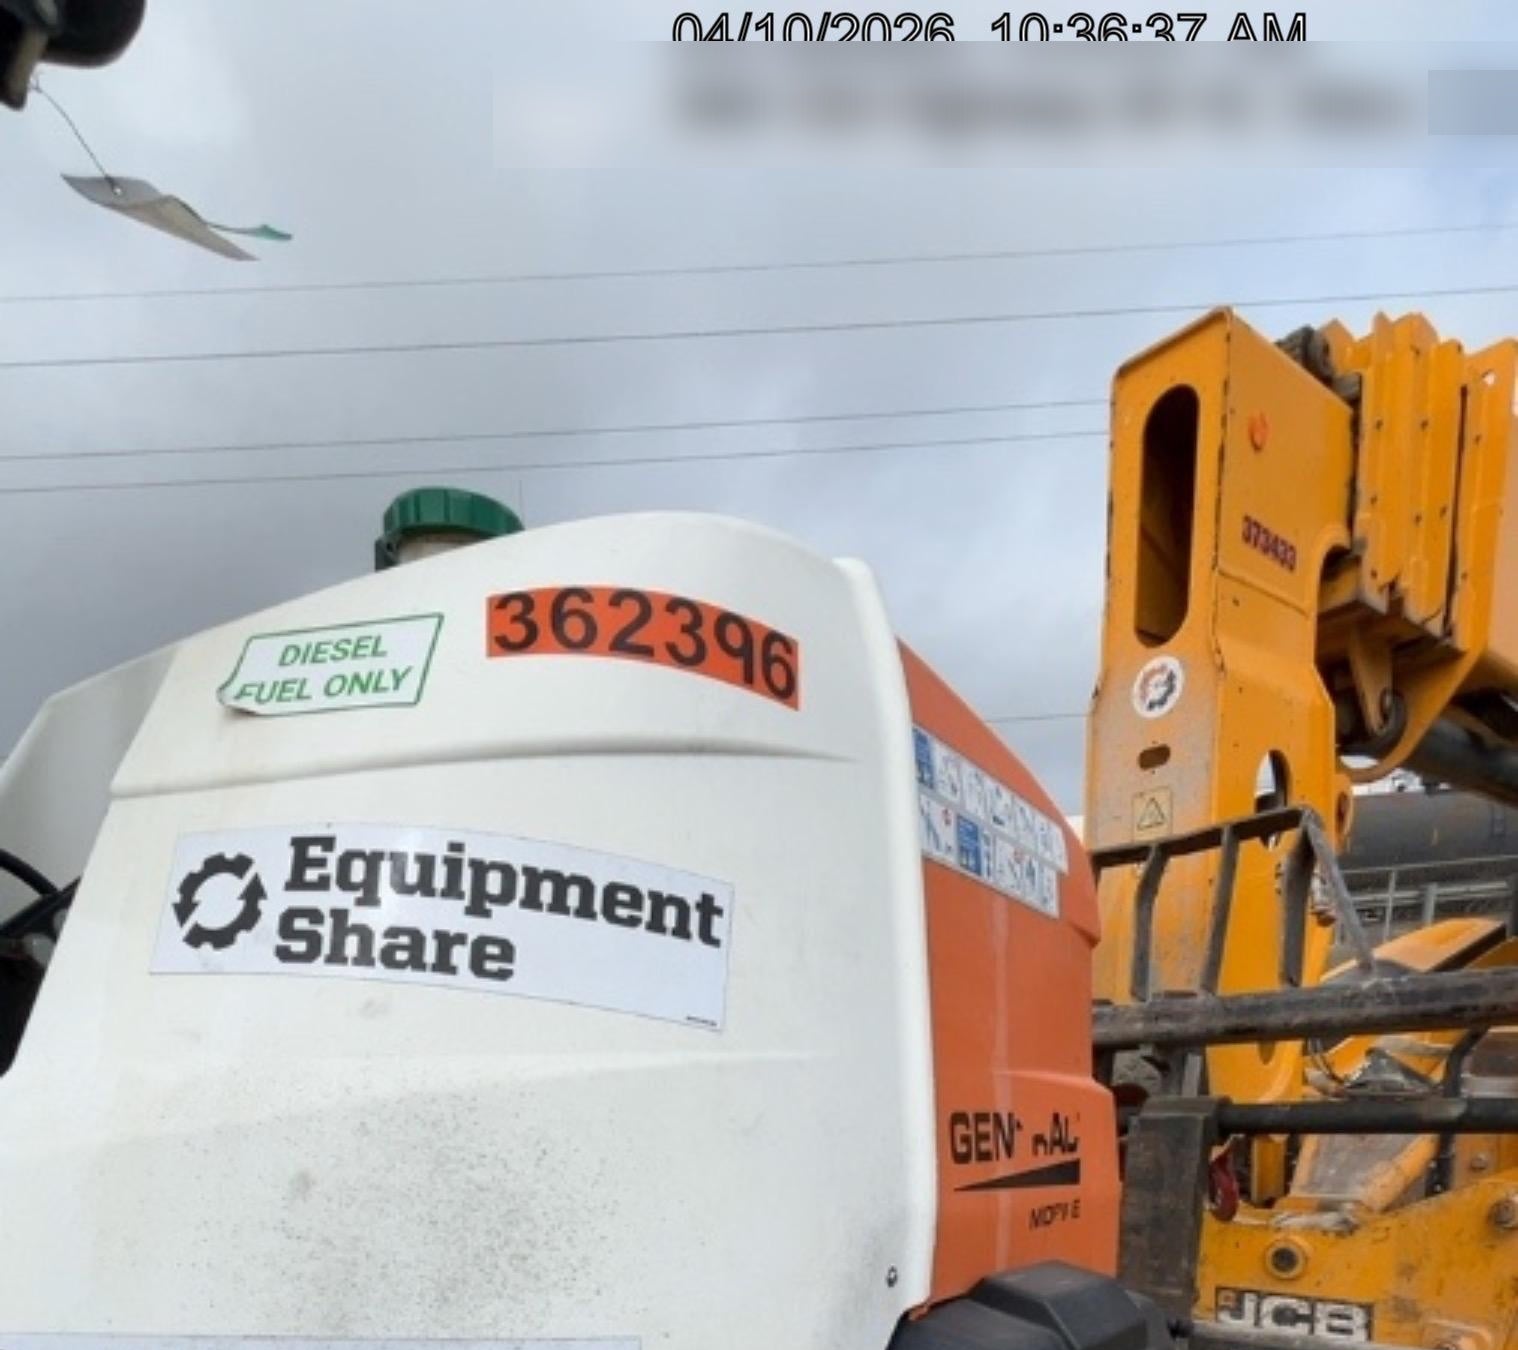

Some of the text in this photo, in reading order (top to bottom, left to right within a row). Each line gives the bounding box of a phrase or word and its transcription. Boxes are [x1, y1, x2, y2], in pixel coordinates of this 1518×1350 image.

[1242, 514, 1296, 573] 373433
[279, 635, 388, 667] DIESEL
[494, 586, 797, 700] 362396
[233, 666, 412, 705] FUEL ONLY
[285, 836, 724, 947] Equipment
[275, 907, 515, 981] Share
[1217, 1290, 1369, 1341] JCB
